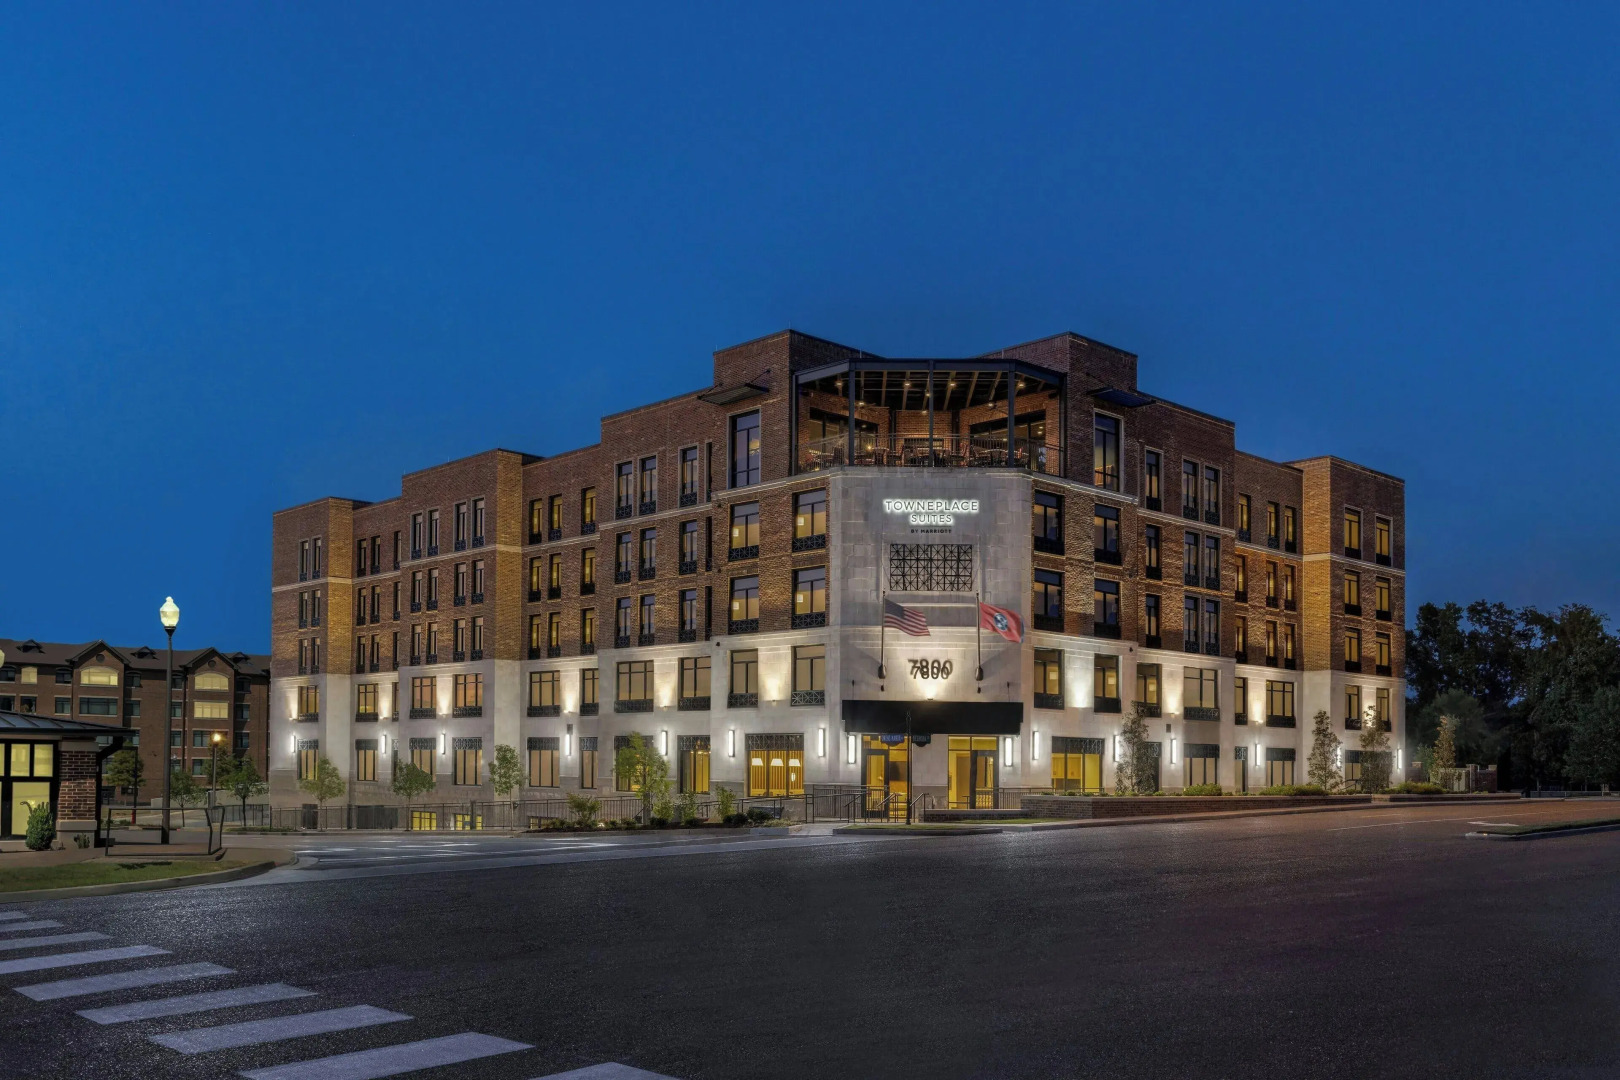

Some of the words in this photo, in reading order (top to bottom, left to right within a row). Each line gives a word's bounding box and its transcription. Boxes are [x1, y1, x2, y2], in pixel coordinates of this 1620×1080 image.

[885, 500, 978, 511] TOWNEPLACE
[910, 514, 952, 523] SUITES
[911, 662, 951, 680] 7800
